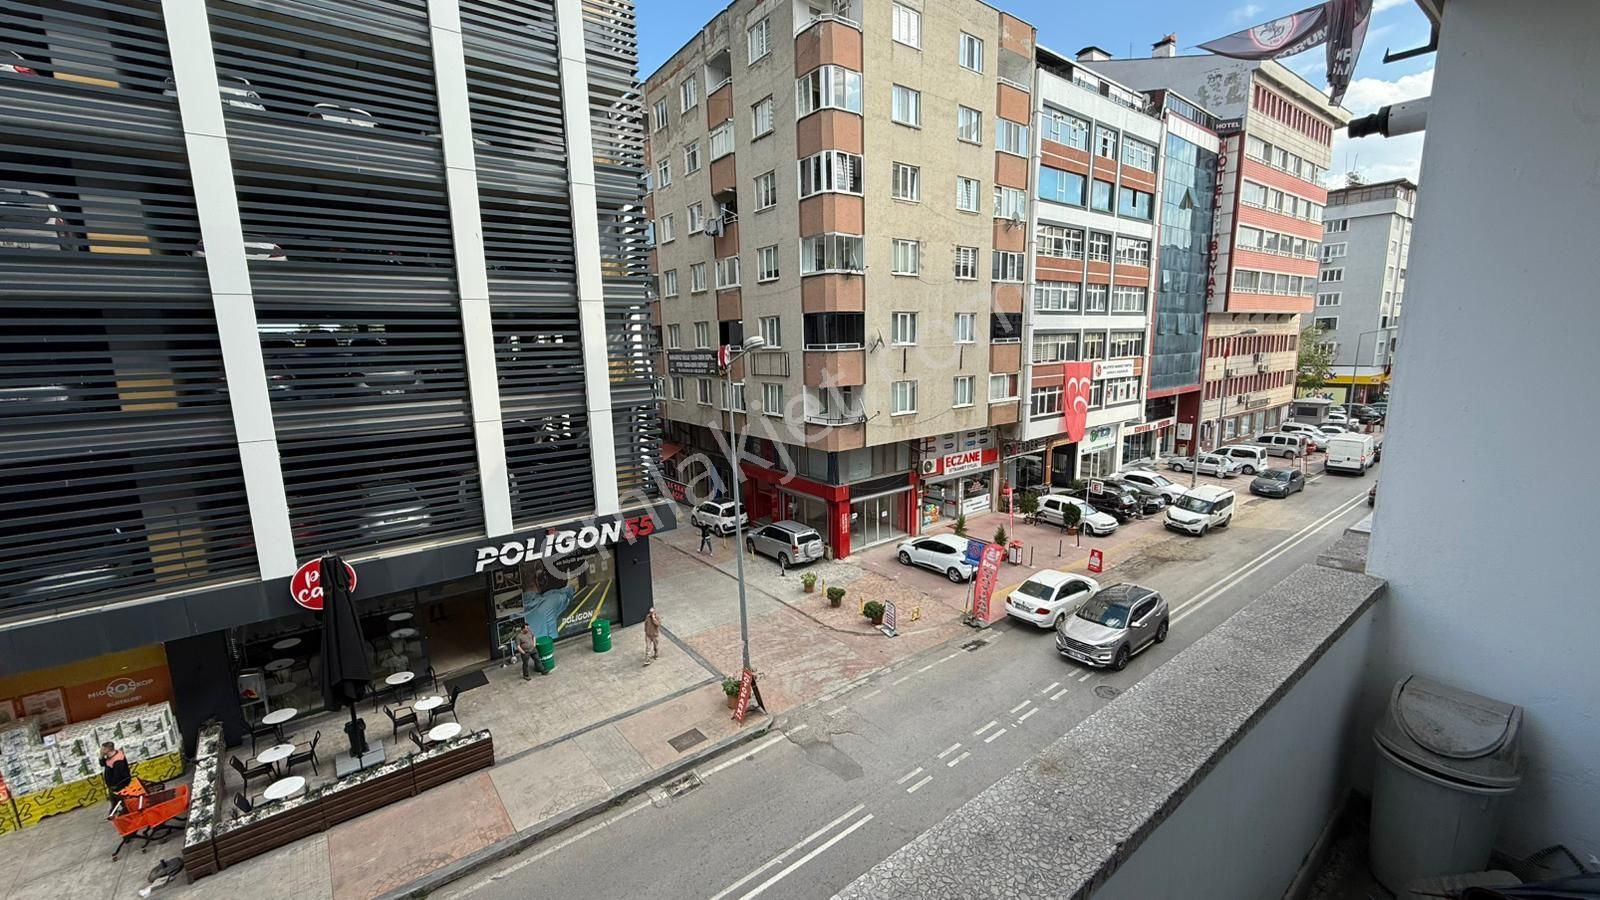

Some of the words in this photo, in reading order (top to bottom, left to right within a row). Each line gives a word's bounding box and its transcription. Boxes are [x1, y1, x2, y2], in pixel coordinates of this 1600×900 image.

[1216, 121, 1240, 130] HOTEL
[1213, 140, 1228, 209] HOTEL
[945, 450, 980, 468] ECZANE
[475, 520, 622, 573] POLİGON
[622, 514, 657, 541] 55
